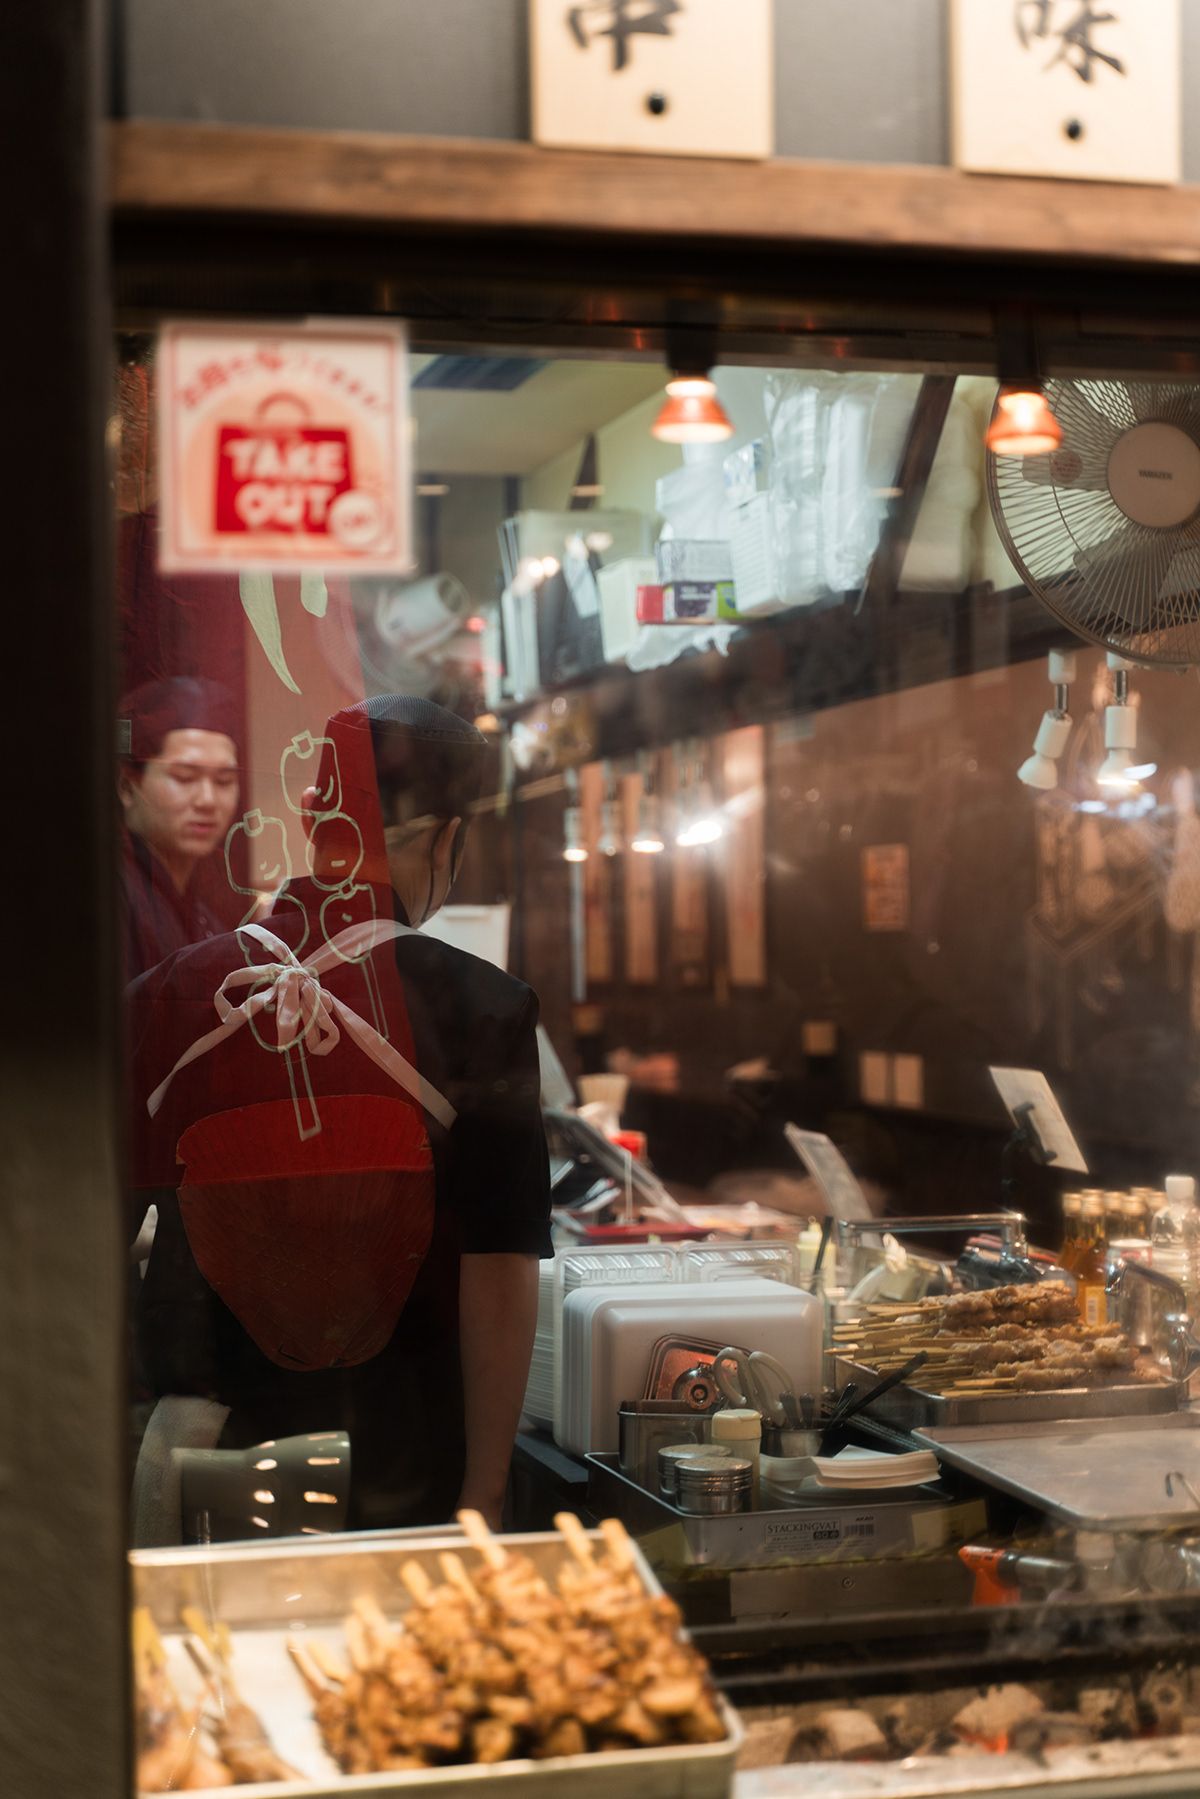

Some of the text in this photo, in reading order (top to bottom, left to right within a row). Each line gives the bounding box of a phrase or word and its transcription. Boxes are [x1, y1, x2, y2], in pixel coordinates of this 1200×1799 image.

[223, 438, 346, 482] TAKE
[235, 482, 336, 529] OUT
[767, 1521, 837, 1534] STACKINGVAT
